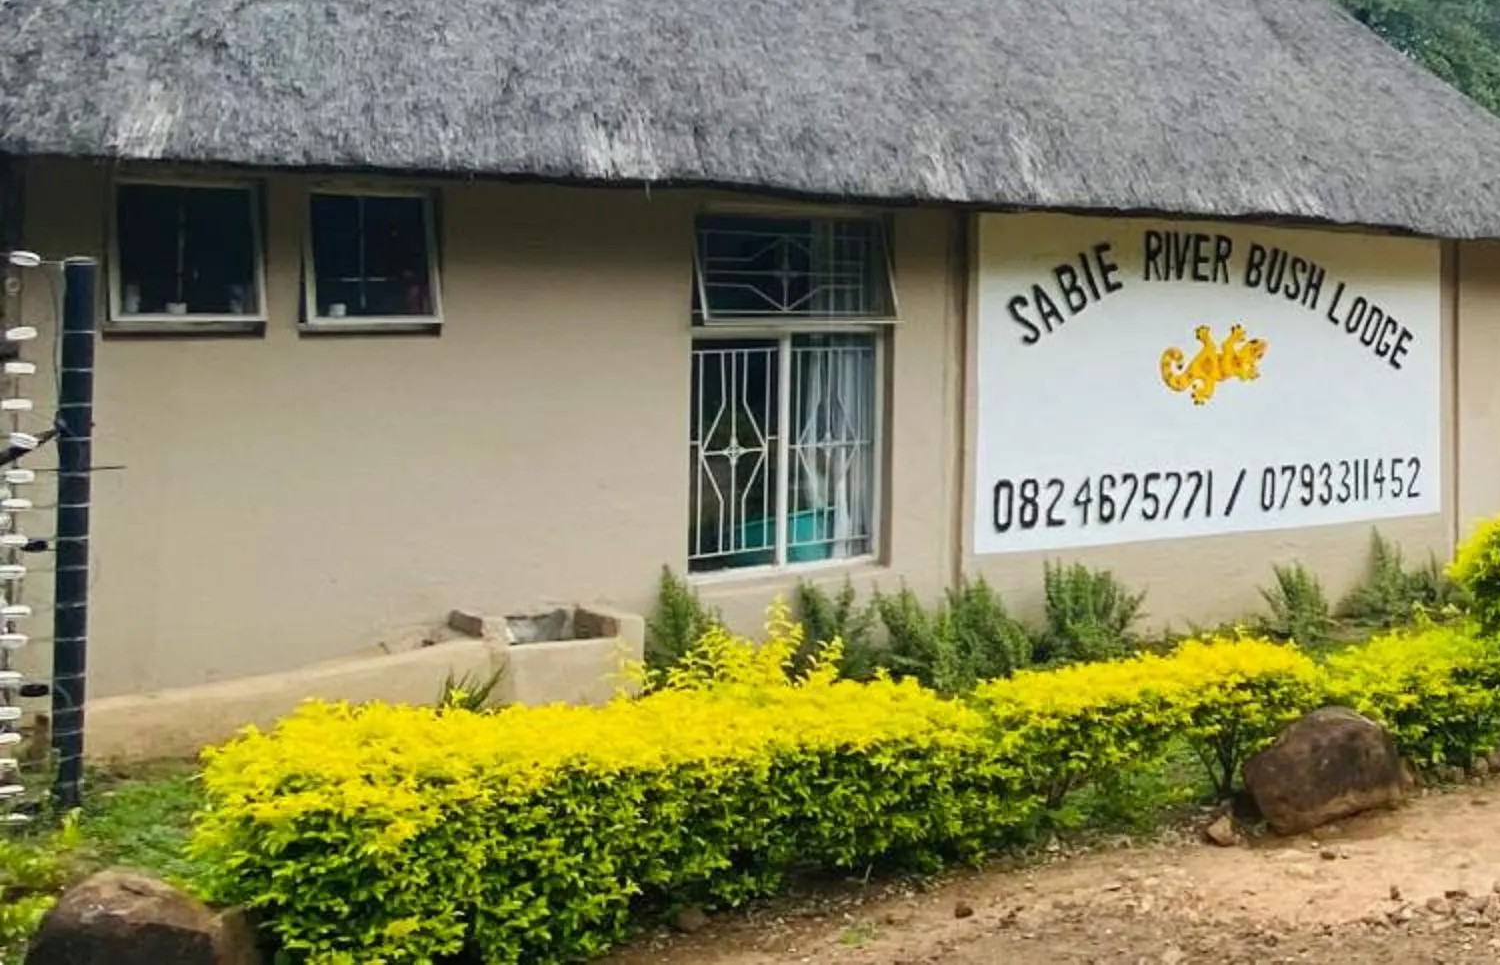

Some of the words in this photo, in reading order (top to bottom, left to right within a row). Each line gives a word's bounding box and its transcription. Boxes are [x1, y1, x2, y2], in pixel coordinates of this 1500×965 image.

[1006, 242, 1123, 345] SABIE
[1144, 230, 1233, 284] RIVER
[1245, 243, 1327, 310] BUSH
[1328, 282, 1414, 370] LODGE
[993, 469, 1213, 533] 0824675771
[1224, 469, 1247, 517] /
[1261, 456, 1422, 512] 0793311452
